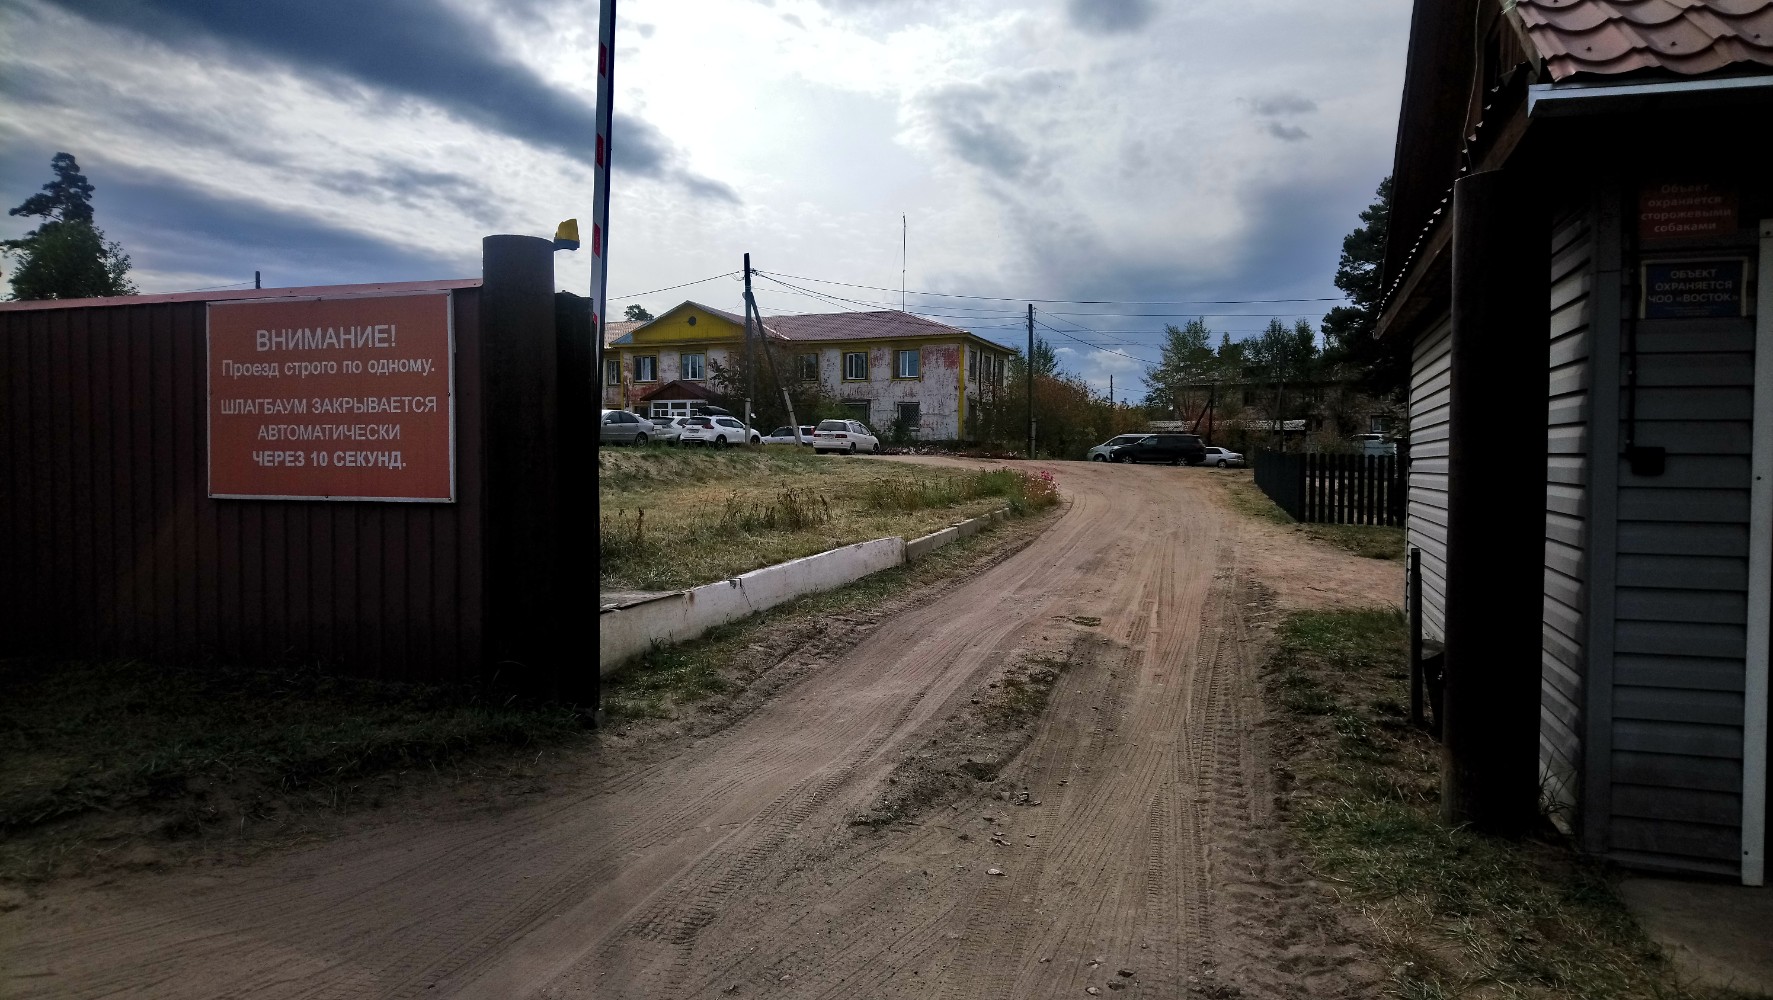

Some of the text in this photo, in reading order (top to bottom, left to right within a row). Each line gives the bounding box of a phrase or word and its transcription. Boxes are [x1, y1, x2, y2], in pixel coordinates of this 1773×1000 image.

[1648, 196, 1721, 208] охраняется
[1641, 209, 1731, 221] сторожевыми
[1654, 222, 1717, 233] собаками
[1670, 269, 1717, 279] ОБЪЕКТ
[1655, 280, 1733, 291] ОХРАНЯЕТСЯ
[1648, 295, 1673, 303] ЧОО
[256, 324, 396, 351] ВНИМАНИЕ!
[222, 358, 435, 379] Проезд строго по одному.
[220, 396, 437, 415] ШЛАГБАУМ ЗАКРЫВАЕТСЯ
[257, 424, 400, 440] АВТОМАТИЧЕСКИ
[253, 450, 407, 470] ЧЕРЕЗ 10 СЕКУНД.
